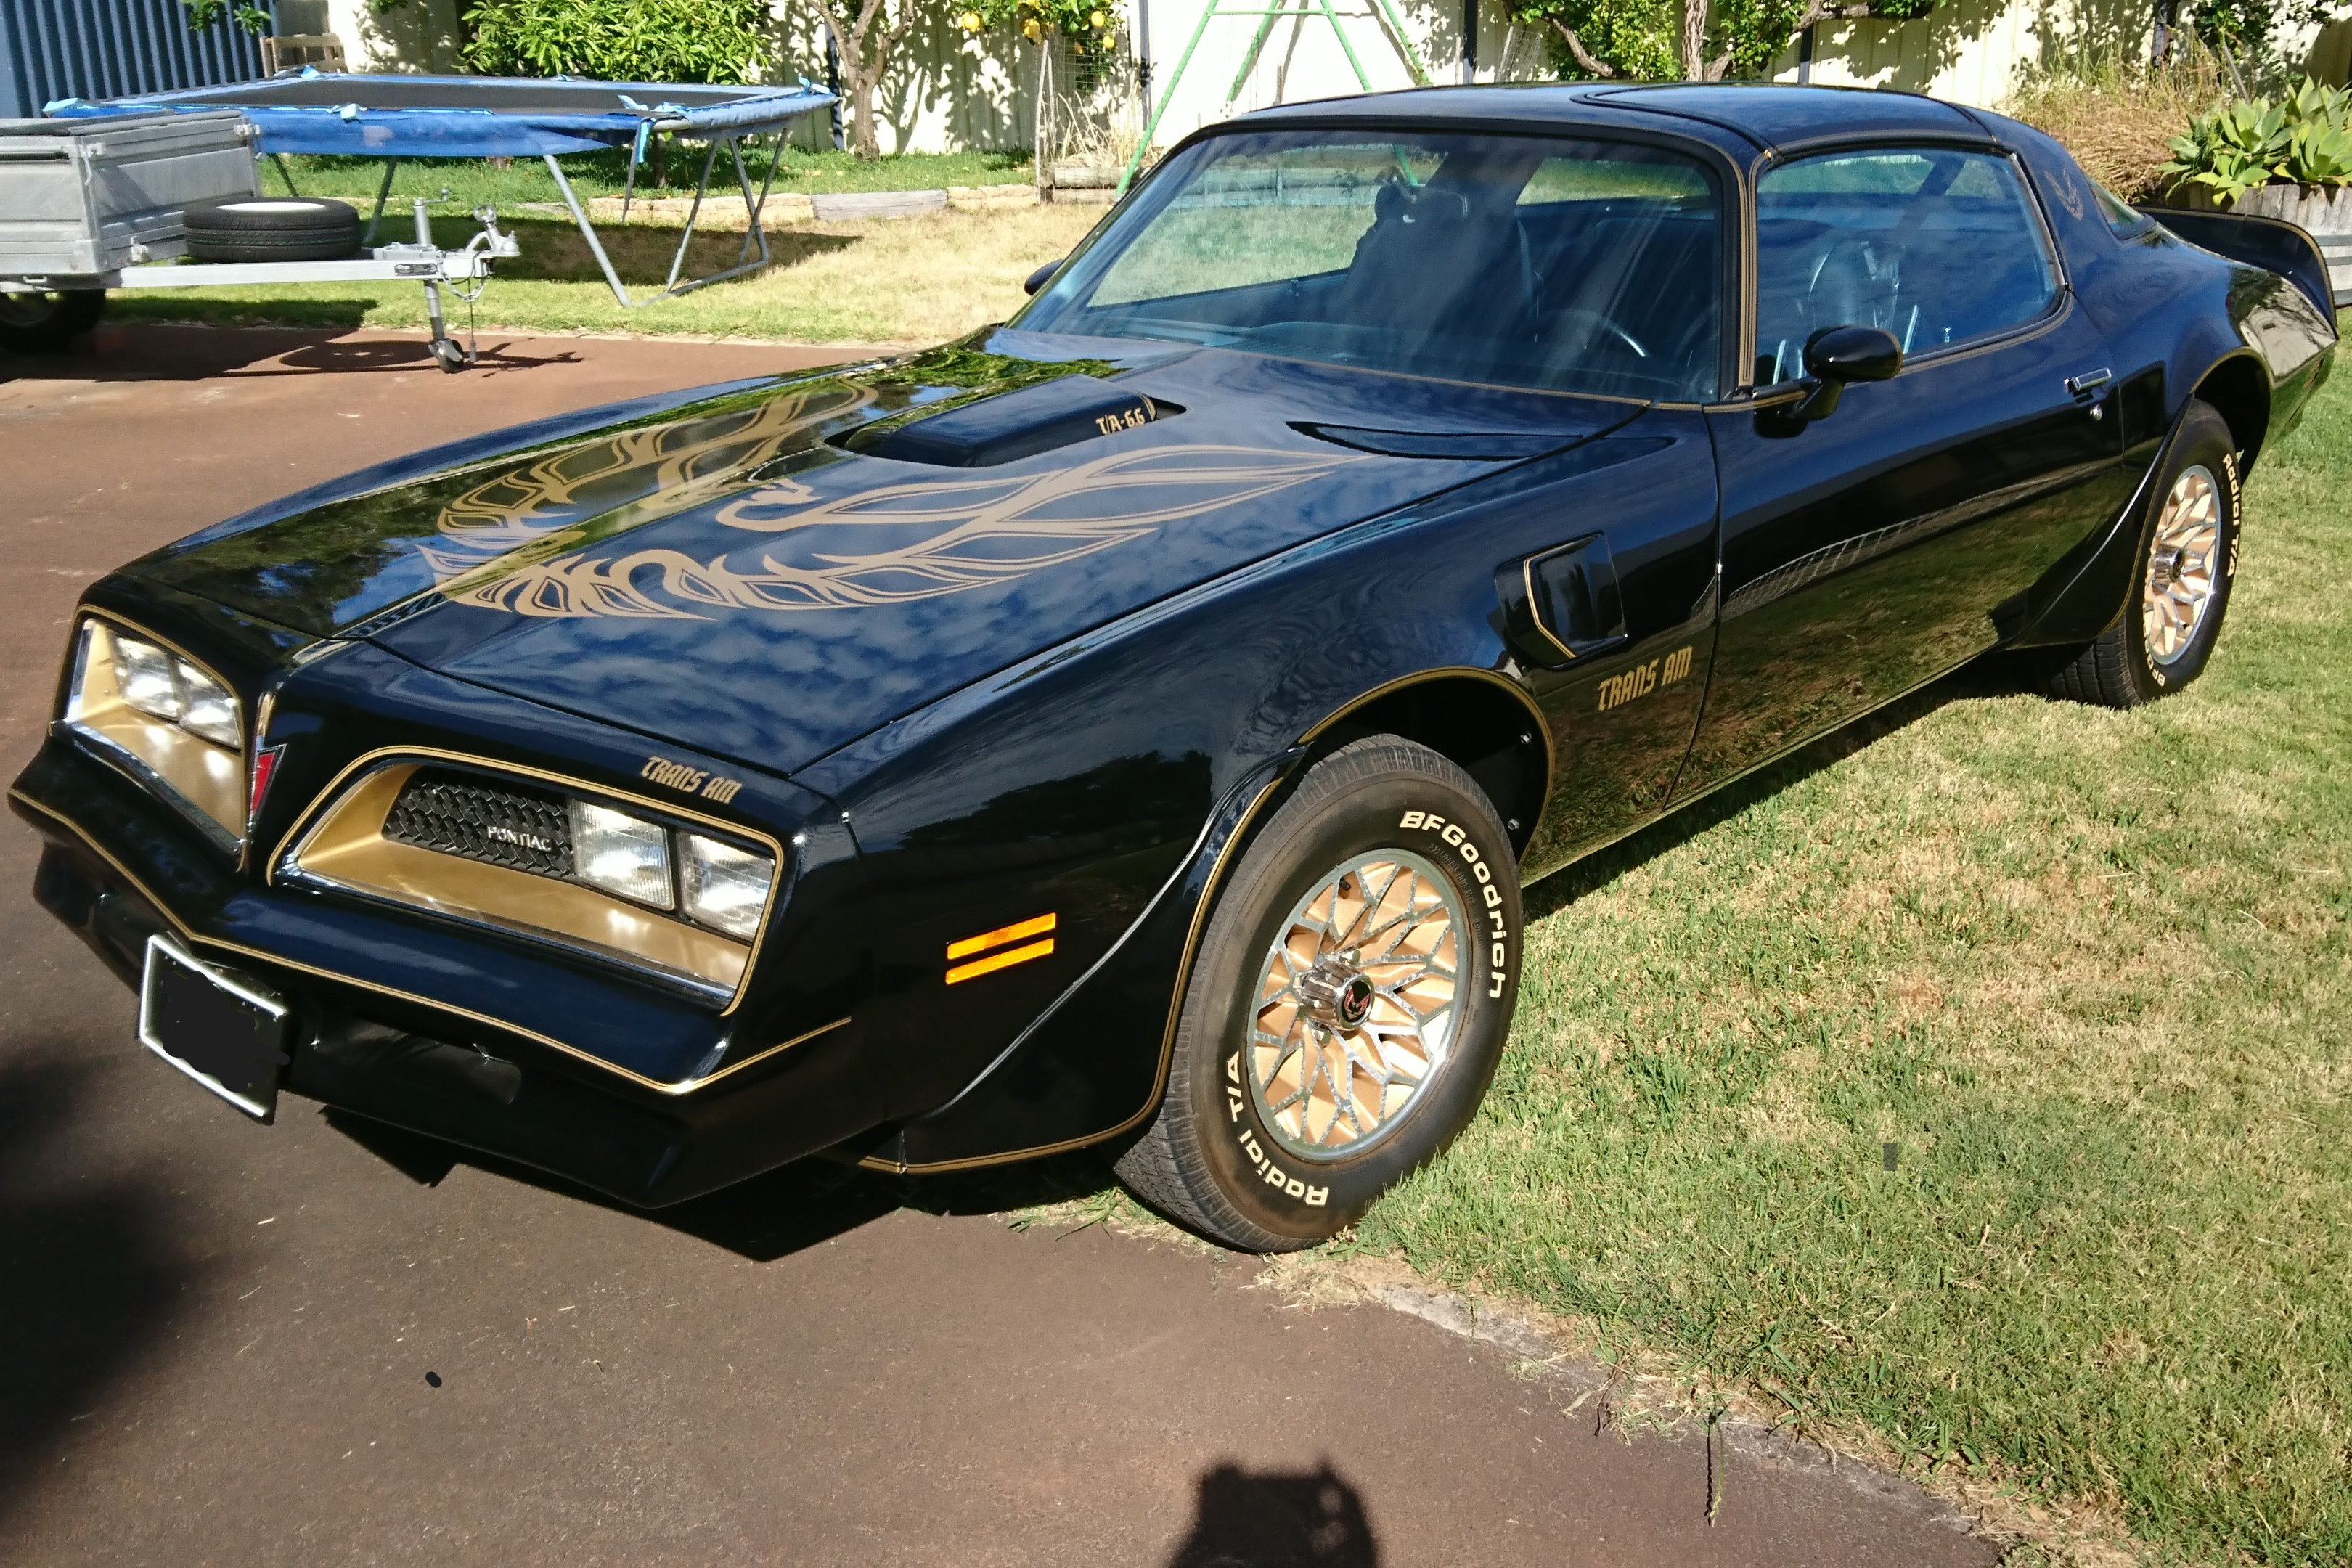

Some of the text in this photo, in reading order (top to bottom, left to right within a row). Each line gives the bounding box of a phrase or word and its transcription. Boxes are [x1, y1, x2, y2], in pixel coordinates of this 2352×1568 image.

[2223, 453, 2240, 577] Radial T/A
[1598, 645, 1693, 712] TRANS AM
[640, 756, 743, 804] TRANS AM
[487, 826, 552, 851] PONTIAC
[1399, 811, 1507, 999] BFGoodrich
[1227, 1050, 1329, 1206] Radial T/A
